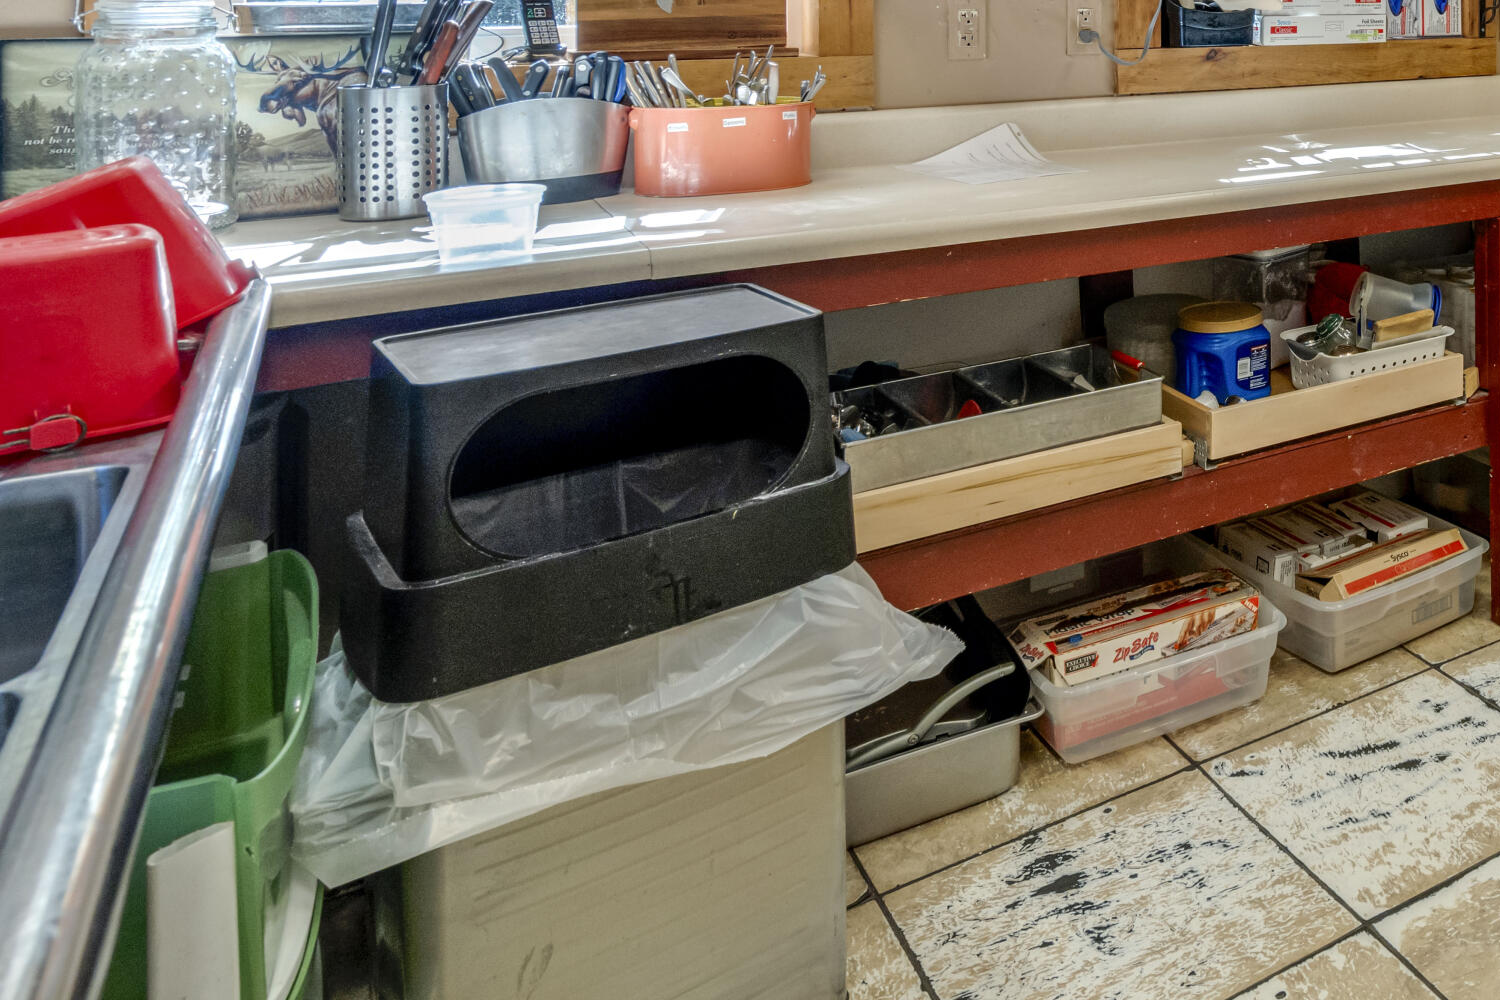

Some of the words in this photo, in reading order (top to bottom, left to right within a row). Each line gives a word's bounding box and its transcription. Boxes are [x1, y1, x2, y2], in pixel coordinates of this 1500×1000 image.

[24, 138, 45, 146] not
[49, 136, 62, 145] be
[1390, 551, 1409, 562] Sysco
[1244, 599, 1258, 613] NEW
[1066, 653, 1097, 667] EXECUTIVE
[1068, 661, 1090, 672] CHOICE
